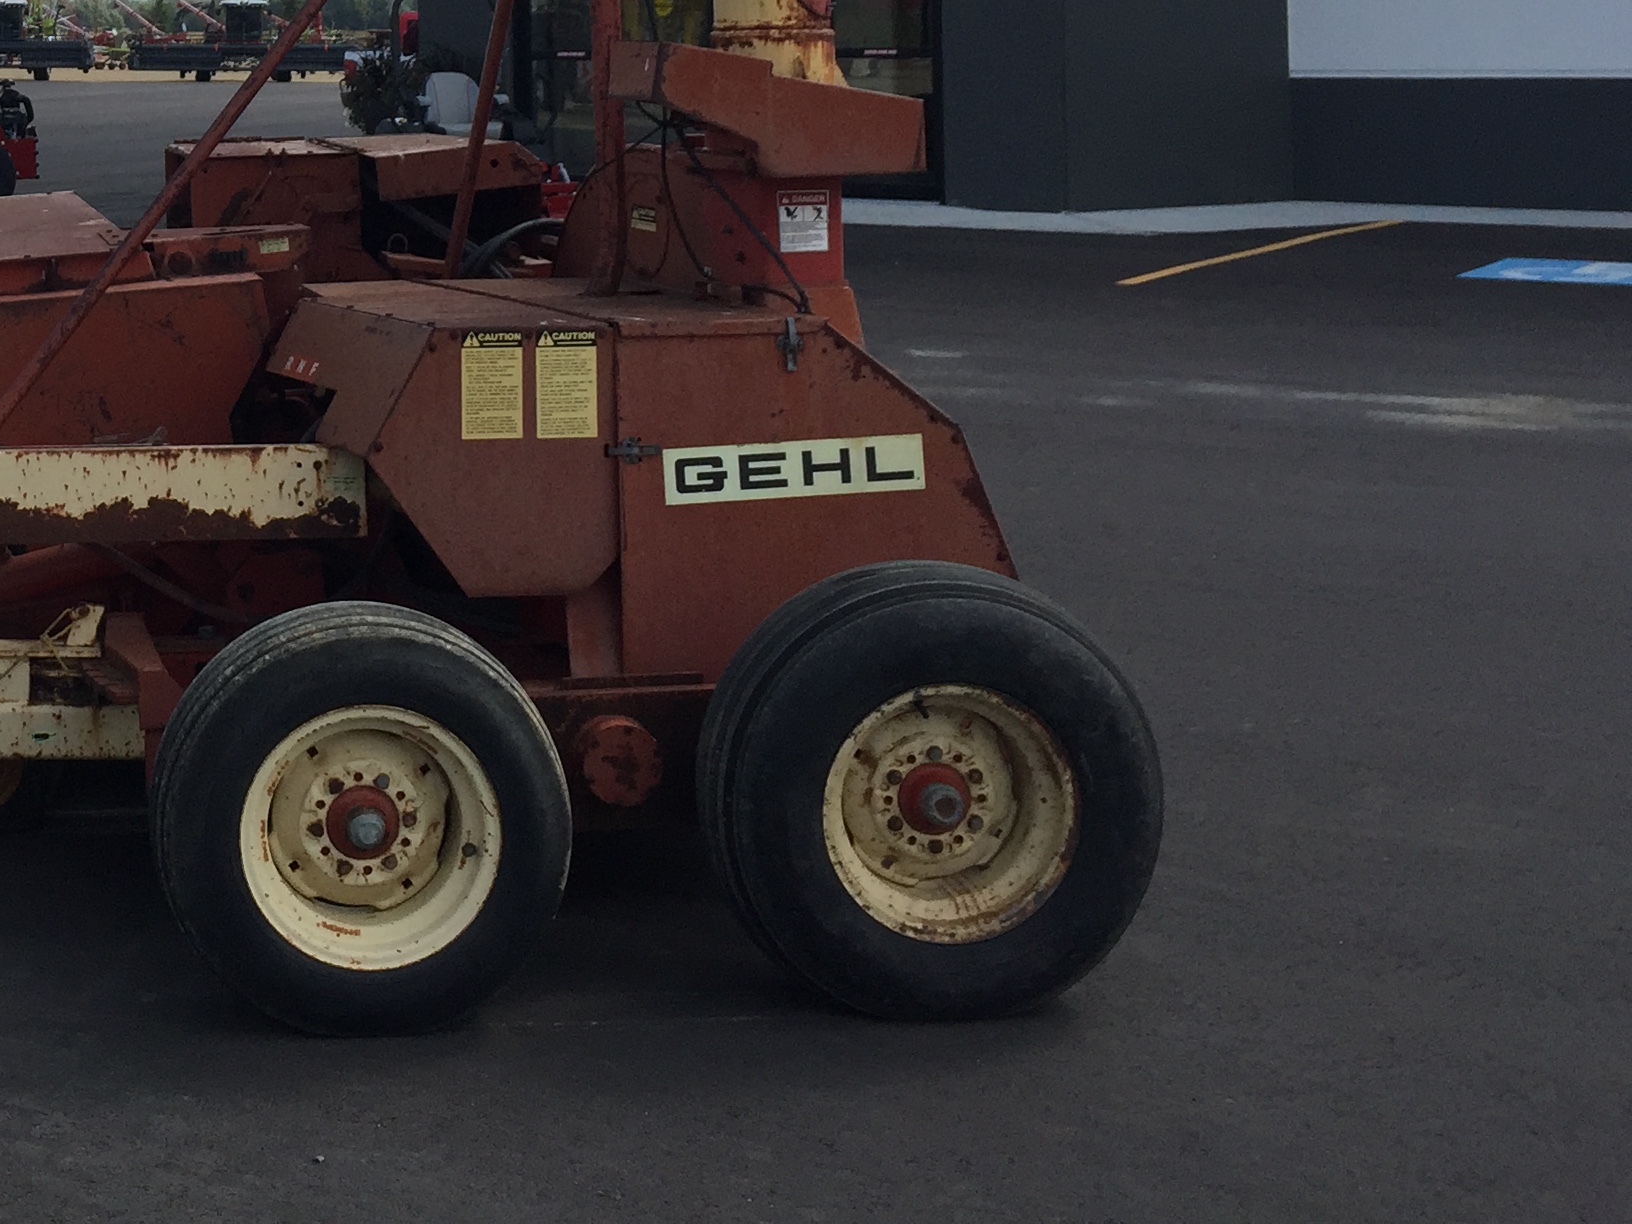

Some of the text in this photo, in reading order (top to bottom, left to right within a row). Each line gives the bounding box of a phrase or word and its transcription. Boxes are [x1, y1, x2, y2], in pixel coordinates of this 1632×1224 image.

[477, 332, 522, 341] CAUTION
[551, 331, 596, 340] CAUTION
[674, 447, 915, 493] GEHL
